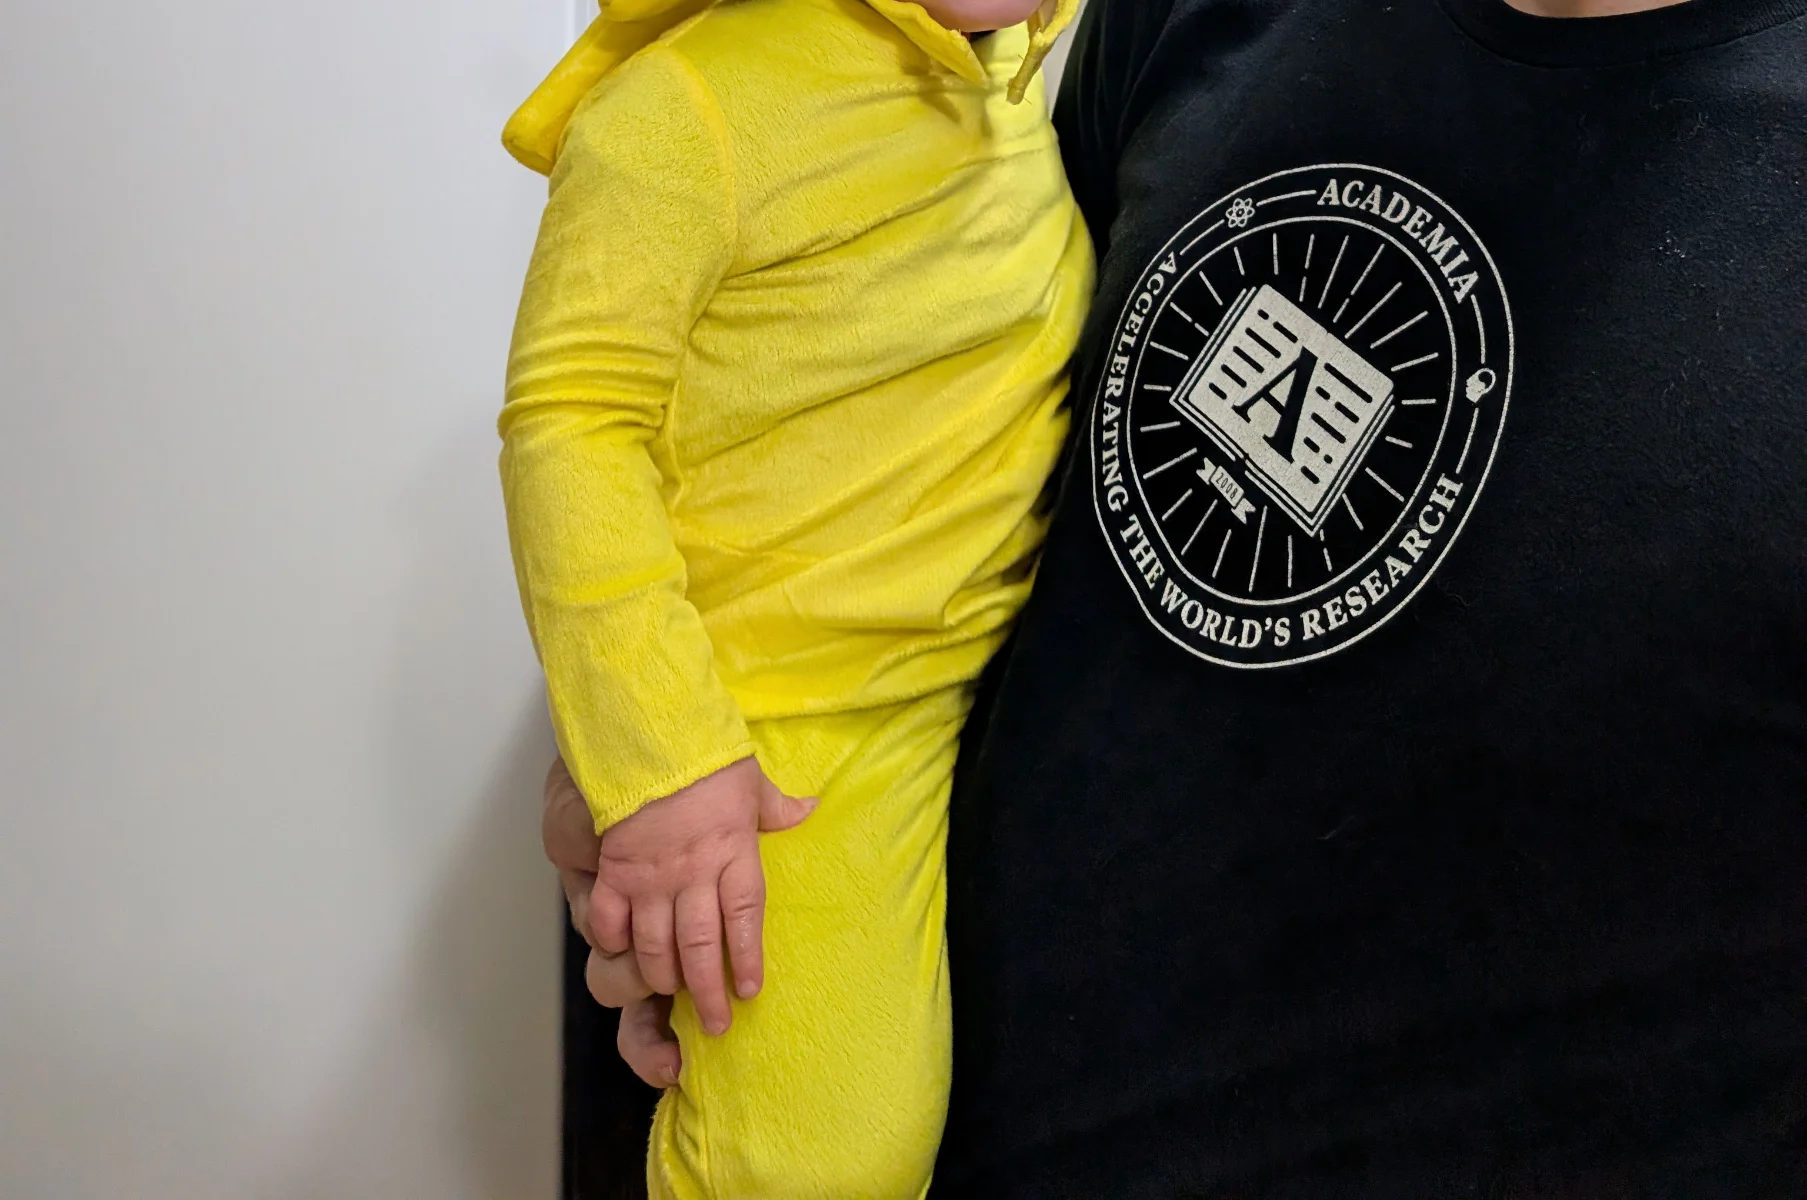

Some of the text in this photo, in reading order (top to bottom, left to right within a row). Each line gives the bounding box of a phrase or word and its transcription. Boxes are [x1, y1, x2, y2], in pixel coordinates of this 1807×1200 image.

[1317, 178, 1480, 304] ACADEMIA
[1100, 252, 1463, 647] ACCELERATING THE WORLD'S RESEARCH
[1231, 345, 1318, 467] A
[1214, 471, 1238, 500] 2008
